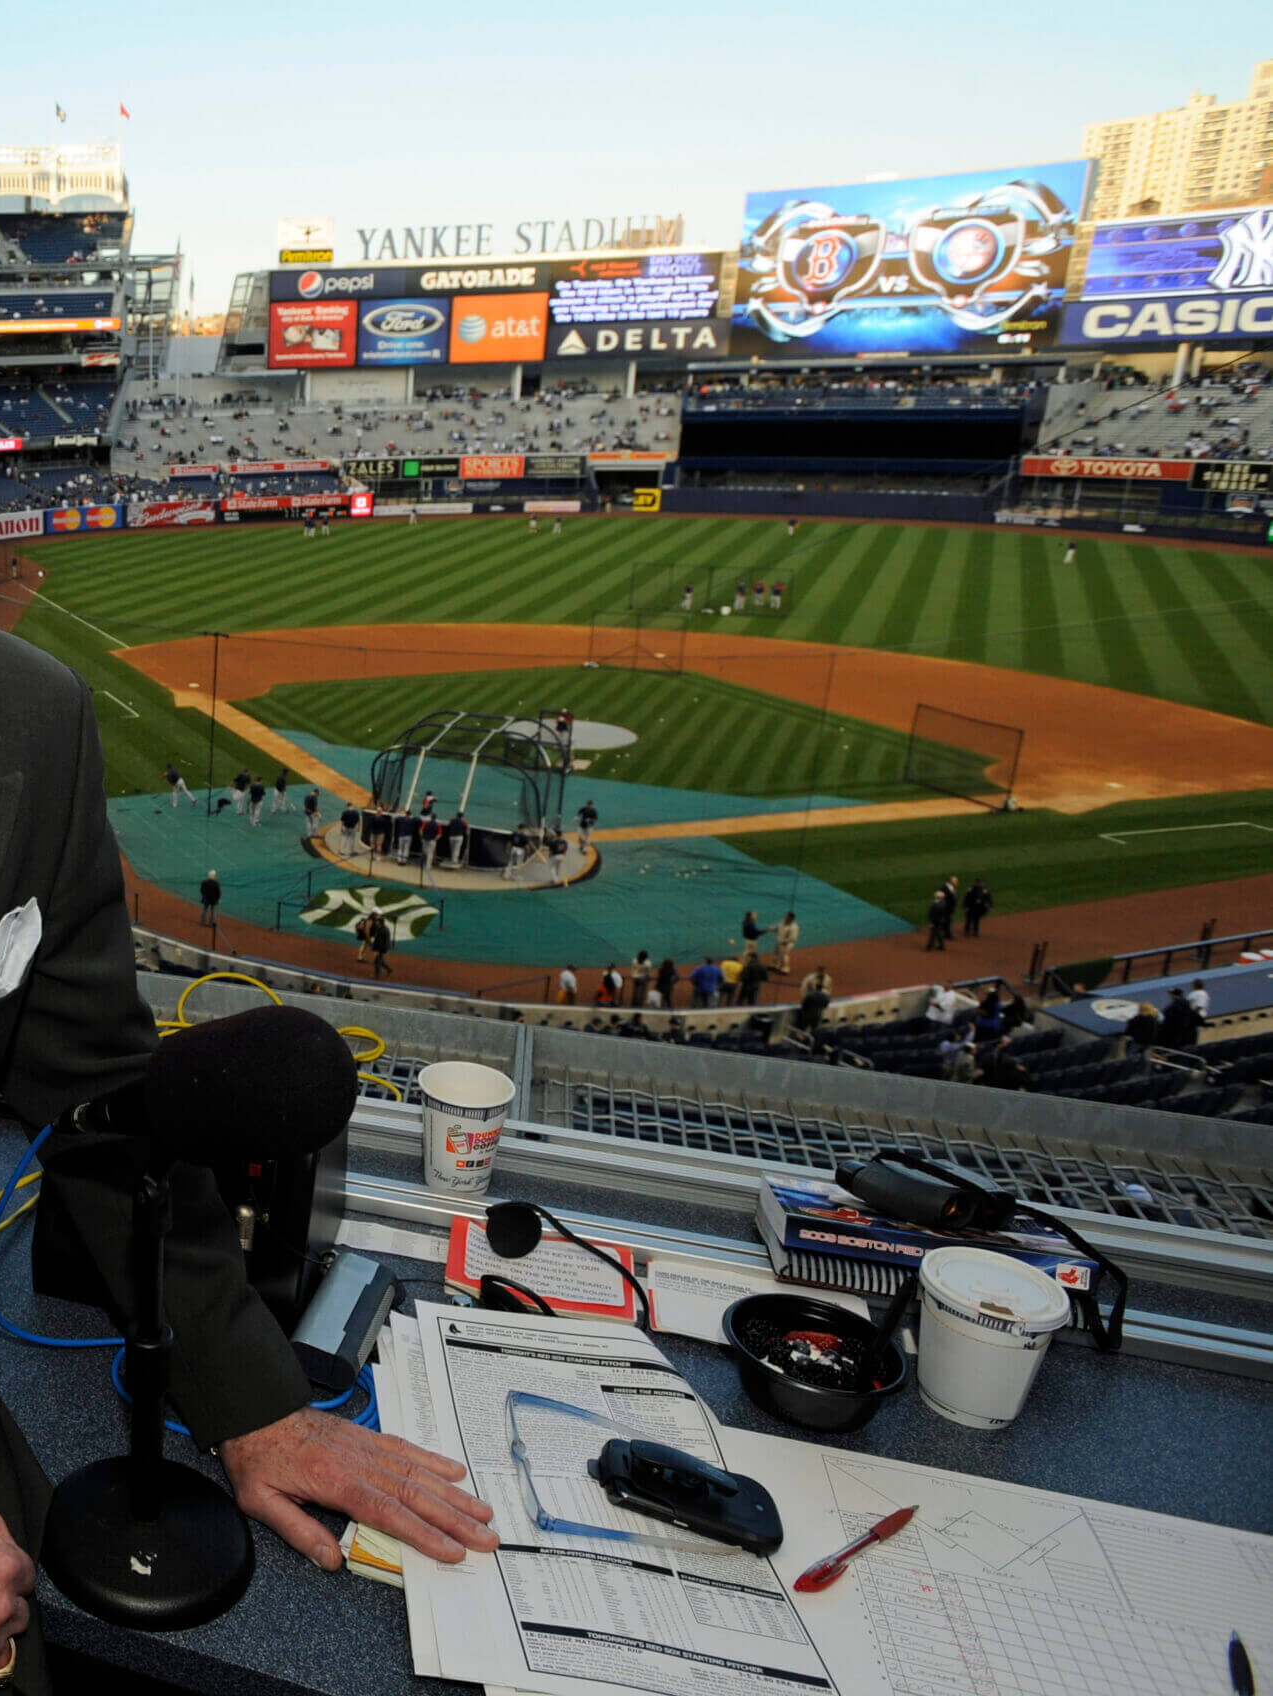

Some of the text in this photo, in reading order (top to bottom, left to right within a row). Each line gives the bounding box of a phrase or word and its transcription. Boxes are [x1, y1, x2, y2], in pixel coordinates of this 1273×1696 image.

[357, 213, 684, 260] YANKEE STADIUM
[324, 273, 374, 293] pepsi
[421, 267, 536, 290] GATORADE
[381, 309, 427, 332] Ford
[491, 315, 540, 338] at&t
[596, 326, 717, 352] DELTA
[350, 460, 394, 475] ZALES
[1081, 460, 1162, 477] TOYOTA
[837, 1234, 895, 1253] BOSTON
[895, 1243, 924, 1257] RED
[576, 1264, 600, 1272] YOUR
[543, 1274, 561, 1282] WEB
[576, 1280, 612, 1290] SEARCH
[566, 1355, 600, 1366] STARTING
[601, 1359, 631, 1367] PITCHER
[614, 1387, 637, 1395] INSIDE
[653, 1390, 686, 1398] NUMBERS
[597, 1554, 633, 1567] MATCHUPS
[680, 1574, 710, 1585] STARTING
[586, 1631, 764, 1674] TOMORROW'S RED SOX STARTING PITCHER
